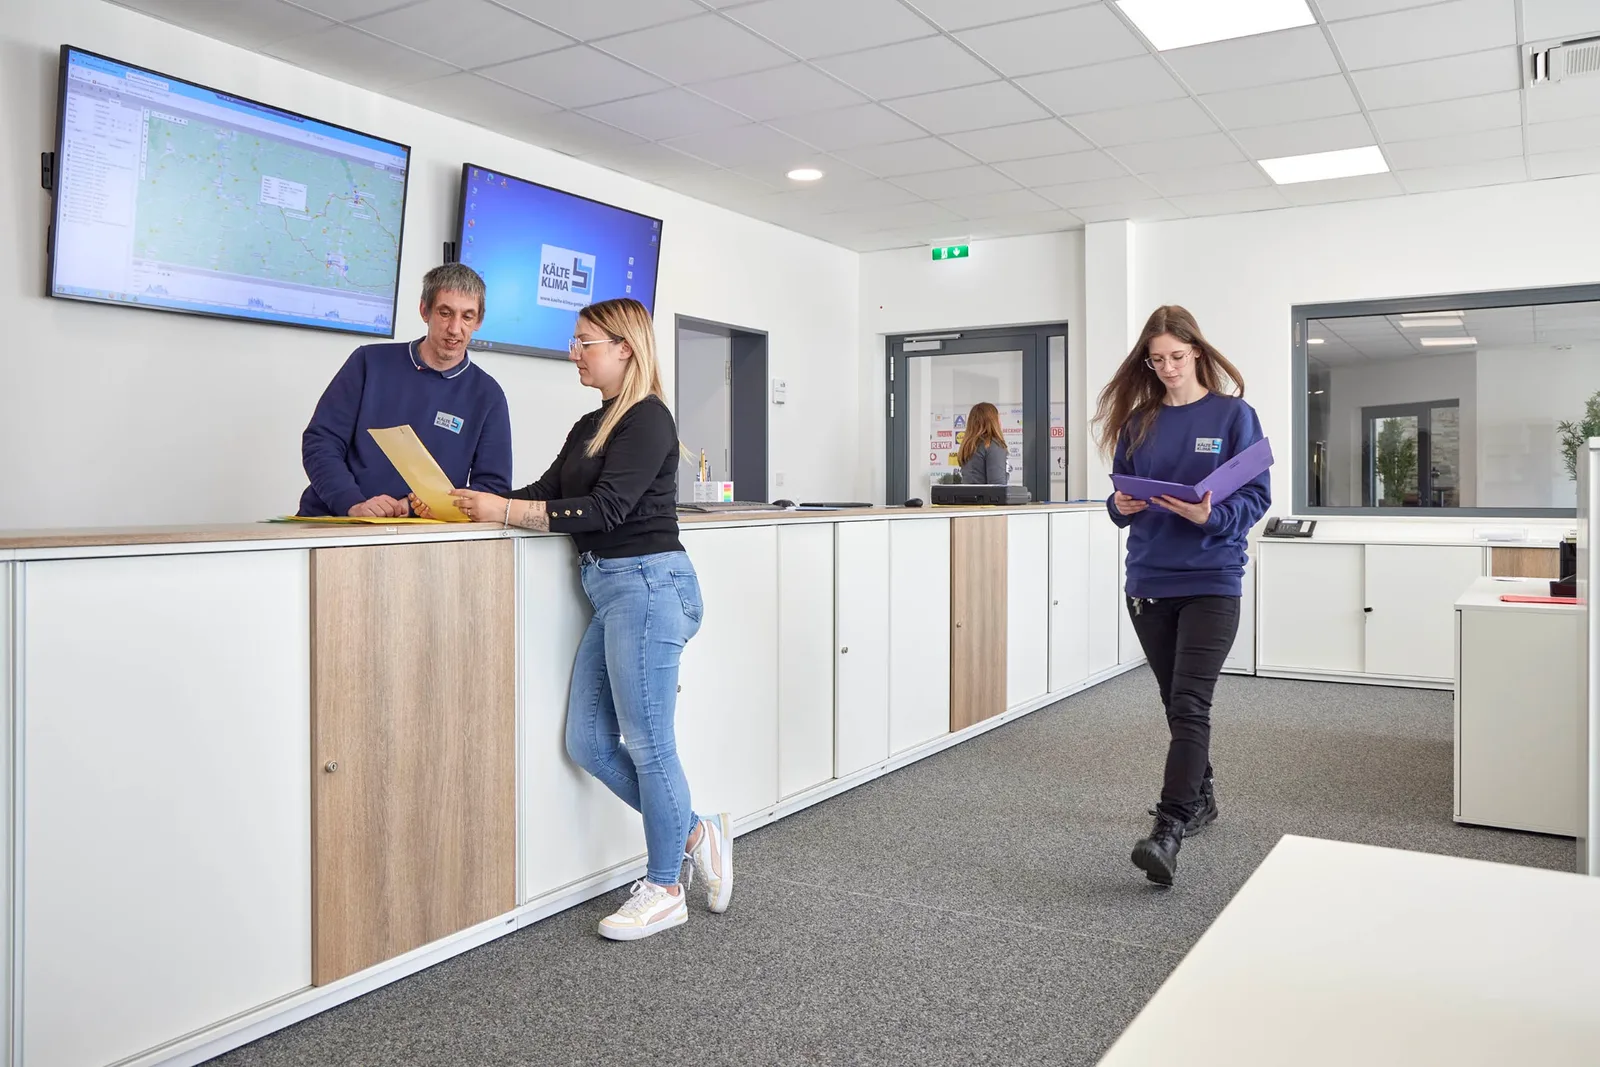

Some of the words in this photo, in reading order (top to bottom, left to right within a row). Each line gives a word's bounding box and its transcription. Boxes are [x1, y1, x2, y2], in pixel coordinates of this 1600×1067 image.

[542, 262, 570, 279] KÄLTE
[541, 276, 569, 291] KLIMA
[1052, 428, 1063, 436] DB
[931, 441, 952, 449] REWE
